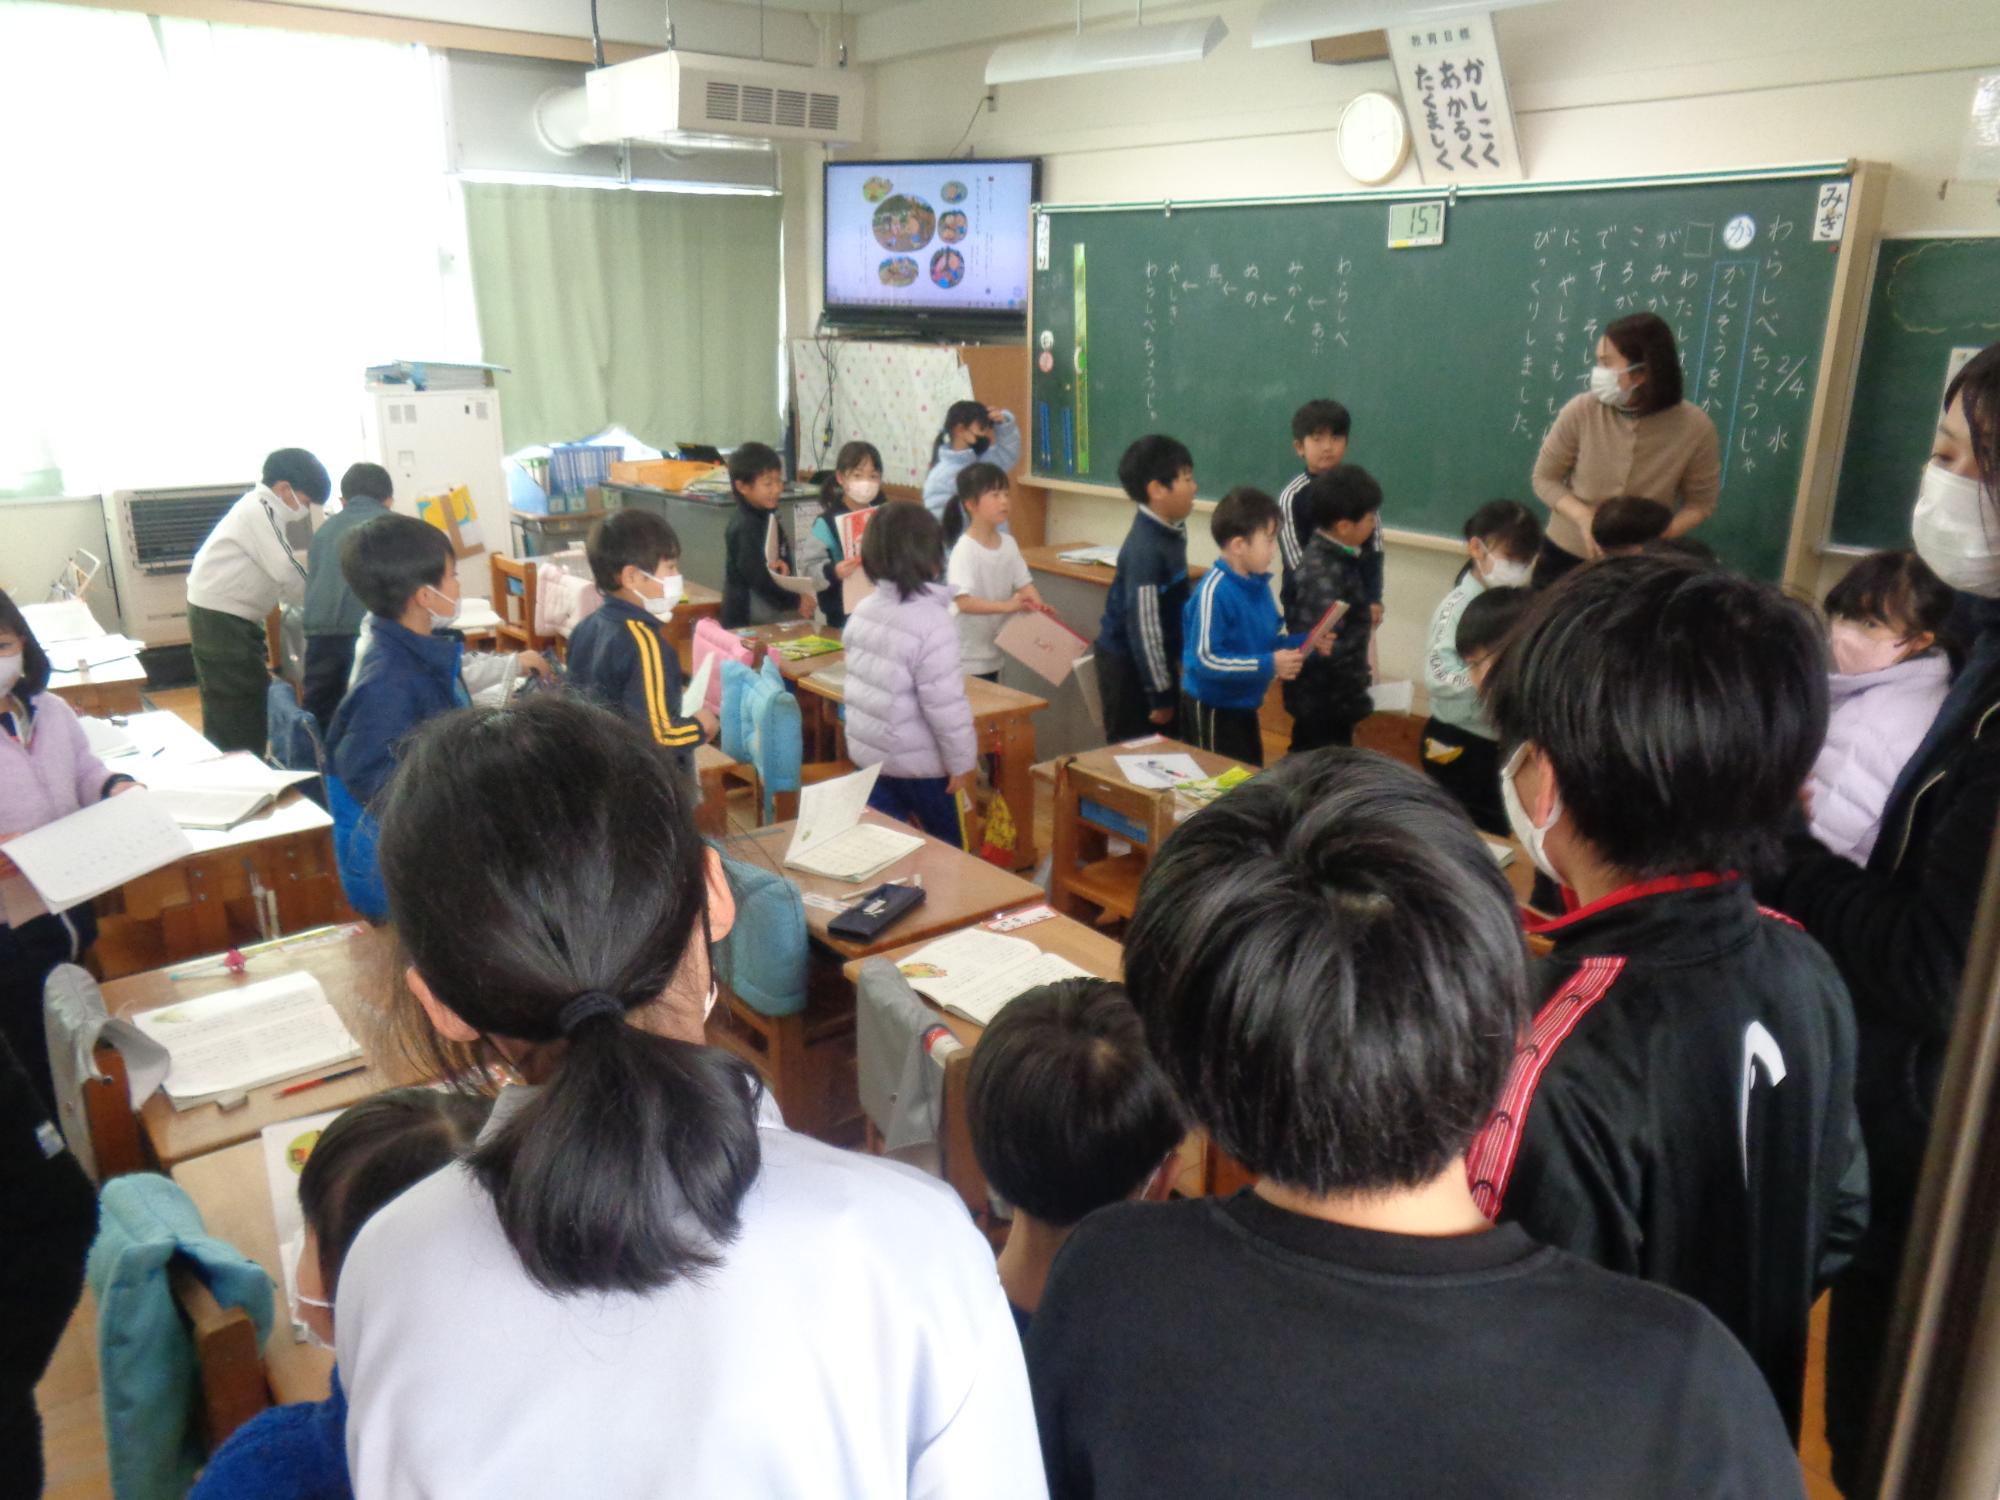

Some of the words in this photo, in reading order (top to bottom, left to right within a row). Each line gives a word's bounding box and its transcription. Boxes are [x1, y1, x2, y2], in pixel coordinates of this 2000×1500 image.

[1415, 64, 1454, 171] たくましく
[1439, 60, 1479, 168] あかるく
[1463, 58, 1500, 168] かしこく
[1819, 186, 1844, 239] みぎ
